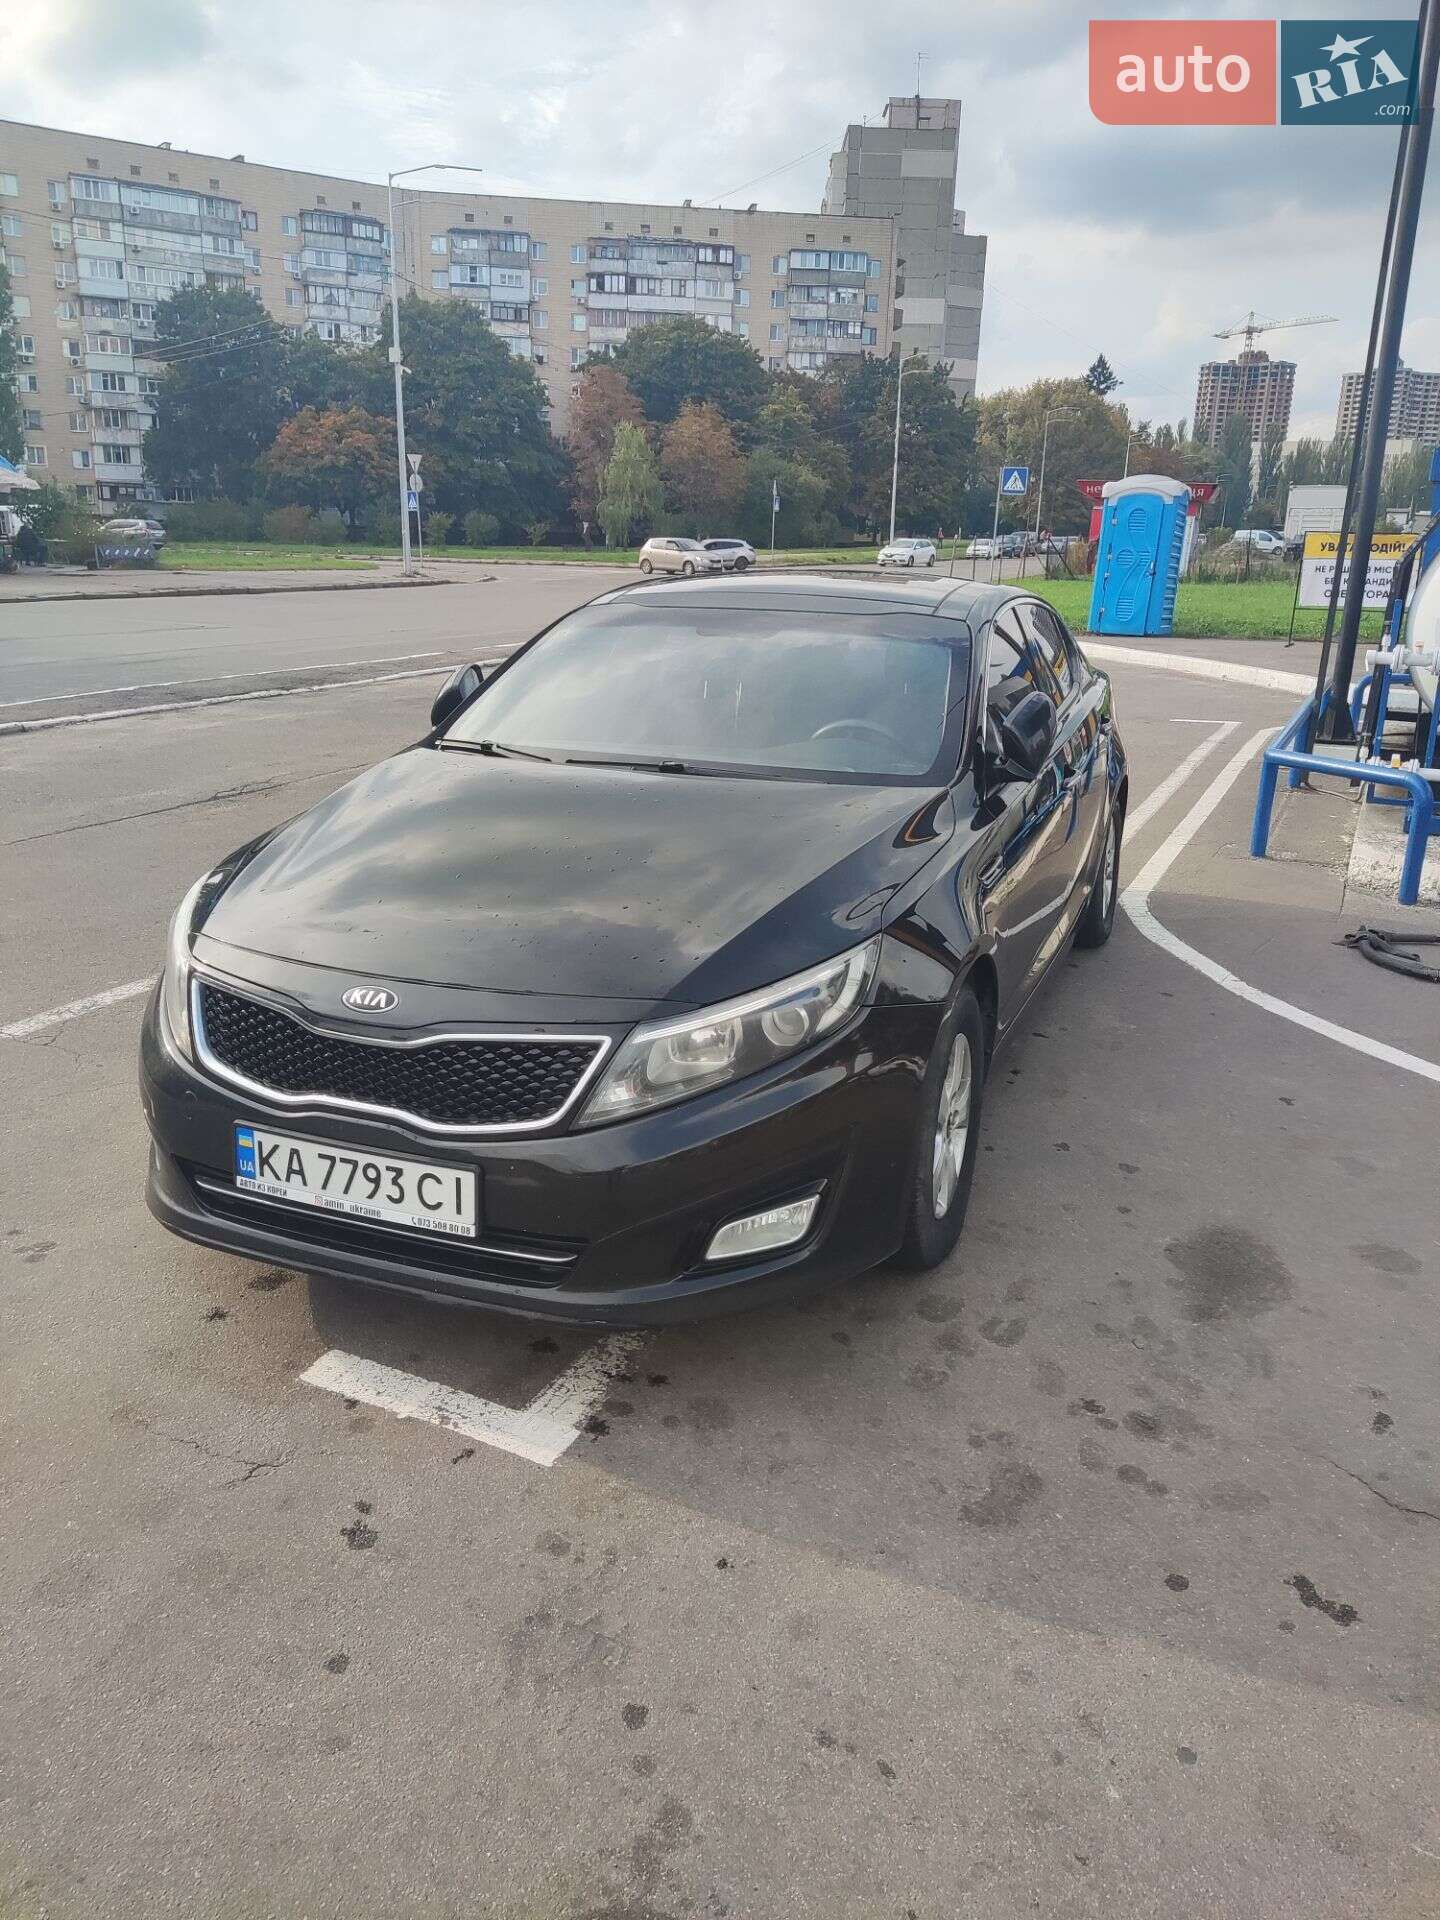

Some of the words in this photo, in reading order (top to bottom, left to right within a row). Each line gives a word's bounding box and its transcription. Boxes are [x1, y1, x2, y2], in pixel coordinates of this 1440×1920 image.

[1368, 540, 1406, 553] ОДІЙ!
[1343, 577, 1393, 586] КАНДИ
[349, 989, 387, 1008] KIA
[239, 1159, 255, 1173] UA
[257, 1140, 308, 1187] KA
[317, 1152, 405, 1204] 7793
[416, 1172, 462, 1216] CI
